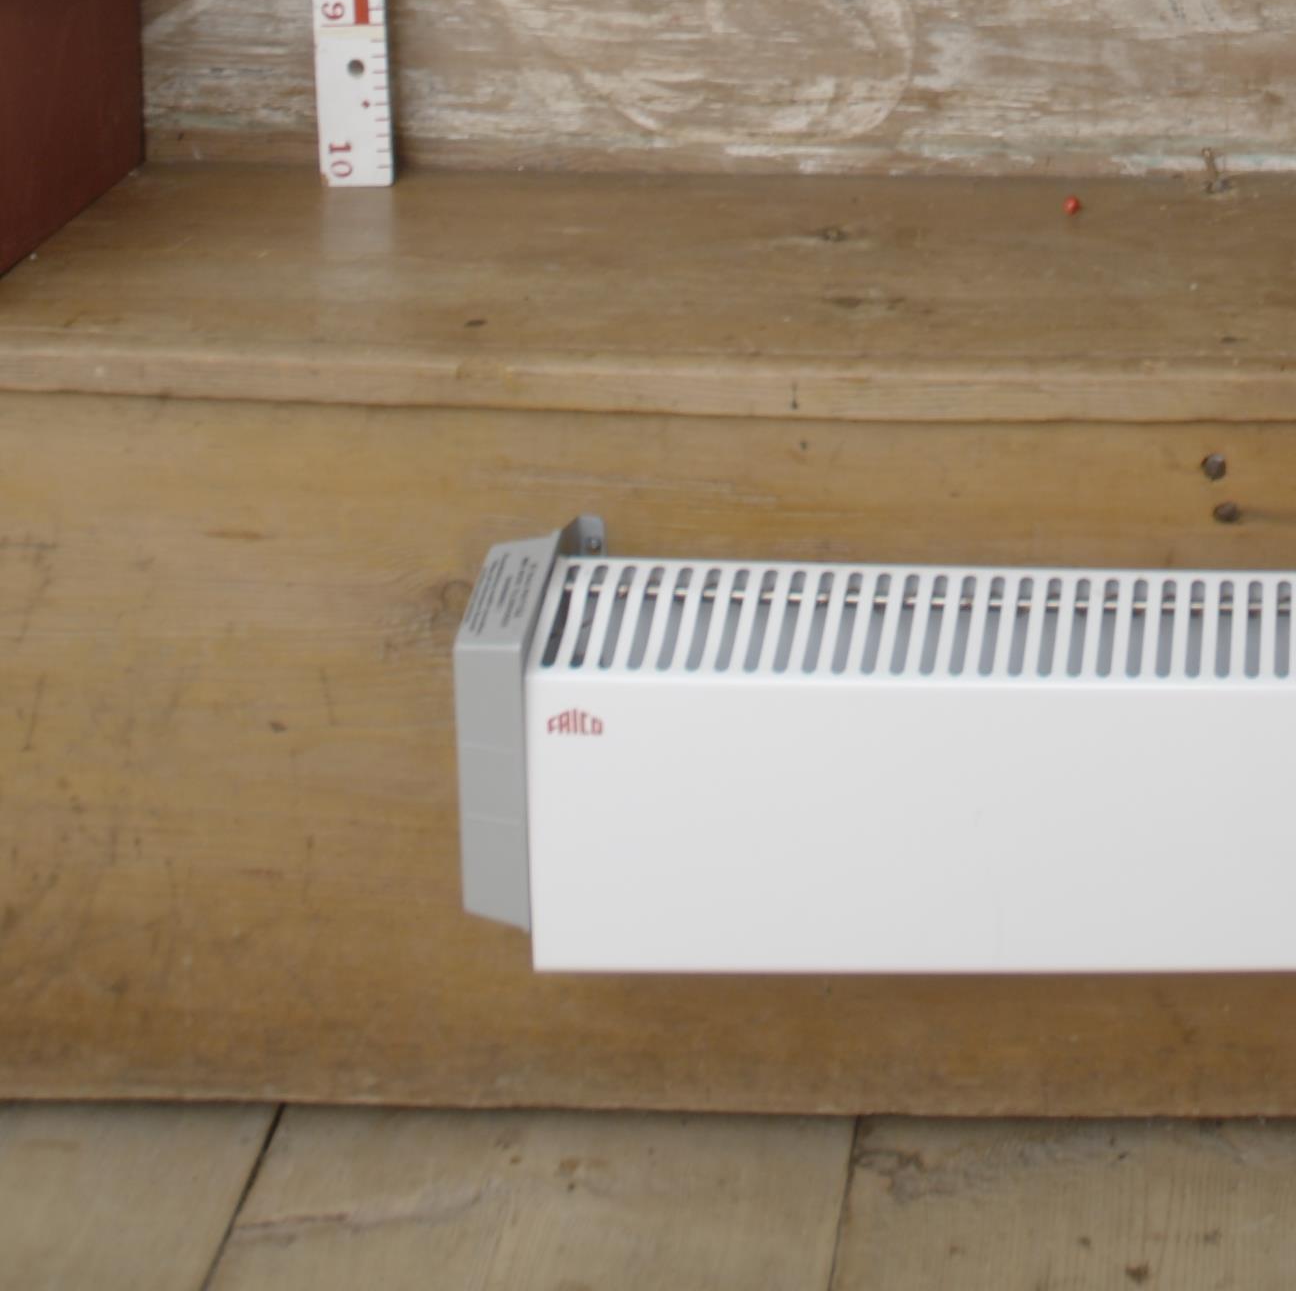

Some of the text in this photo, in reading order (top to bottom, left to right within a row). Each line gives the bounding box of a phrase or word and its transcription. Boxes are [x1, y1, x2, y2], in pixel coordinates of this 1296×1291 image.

[321, 1, 345, 21] 9
[328, 141, 353, 179] 10
[546, 707, 604, 737] FRICO
